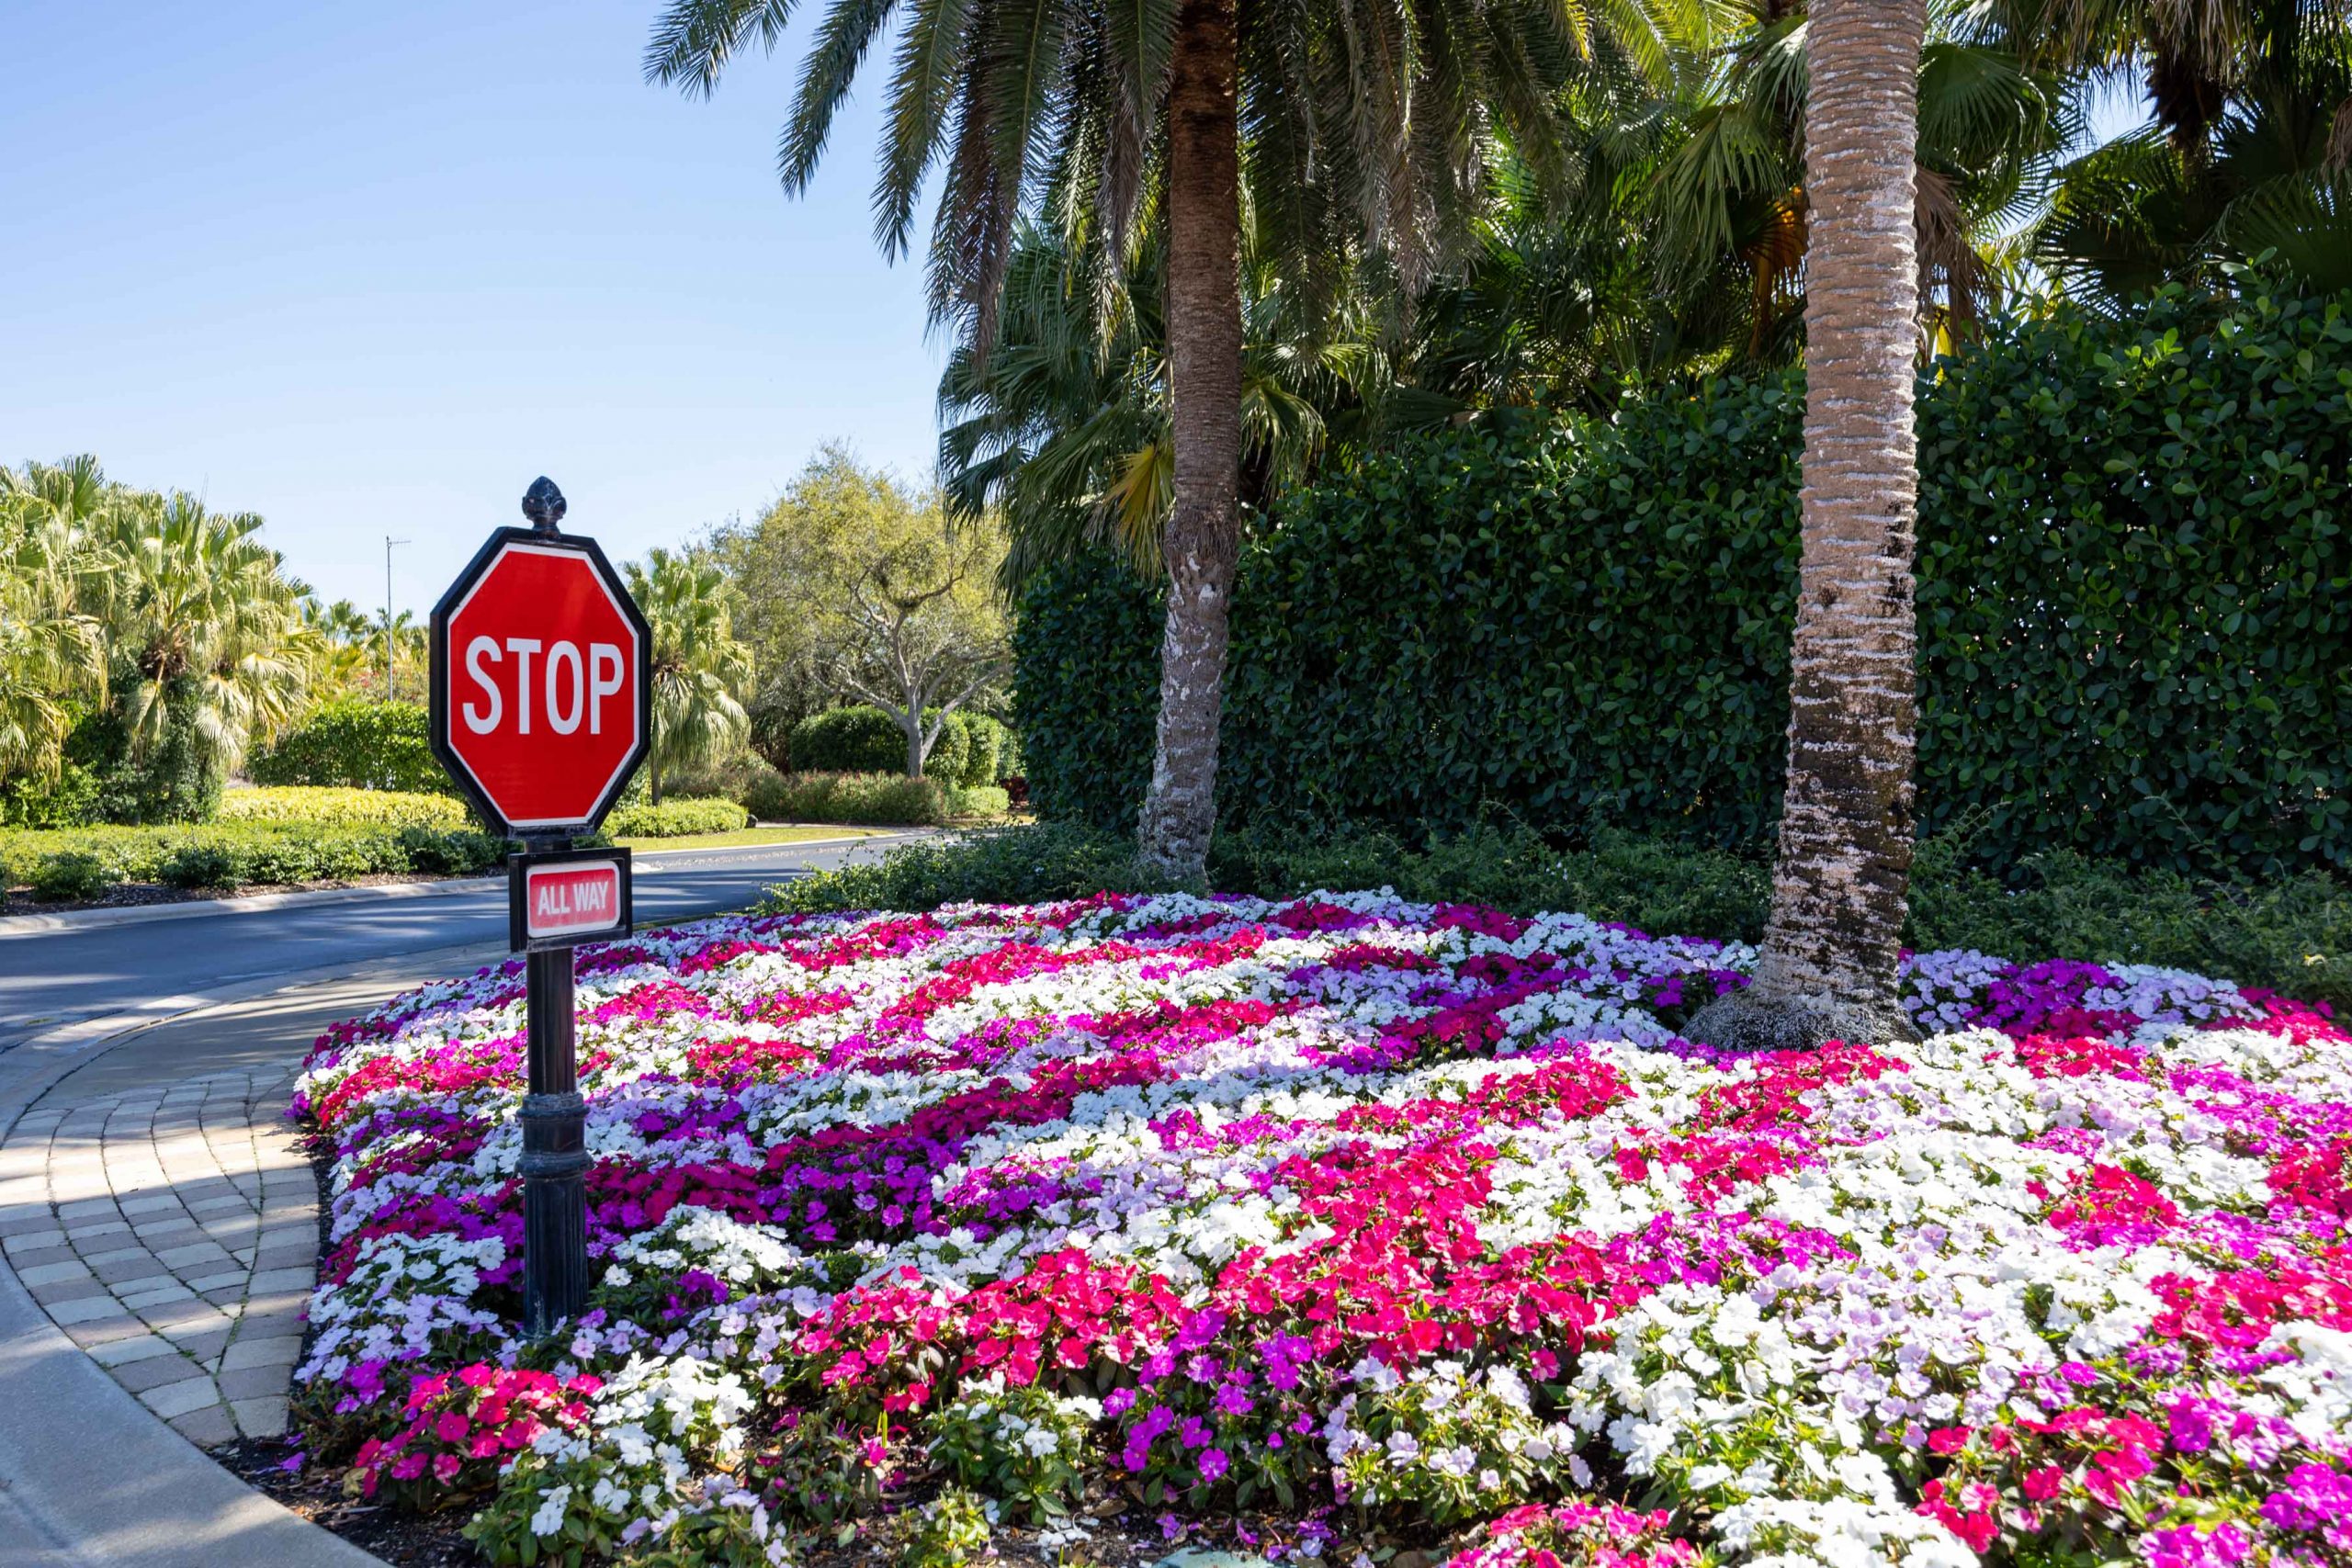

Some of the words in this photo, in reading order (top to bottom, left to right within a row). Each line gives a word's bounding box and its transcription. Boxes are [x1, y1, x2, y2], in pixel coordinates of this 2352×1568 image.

[462, 635, 625, 735] STOP
[537, 885, 571, 916] ALL
[572, 880, 608, 912] WAY
